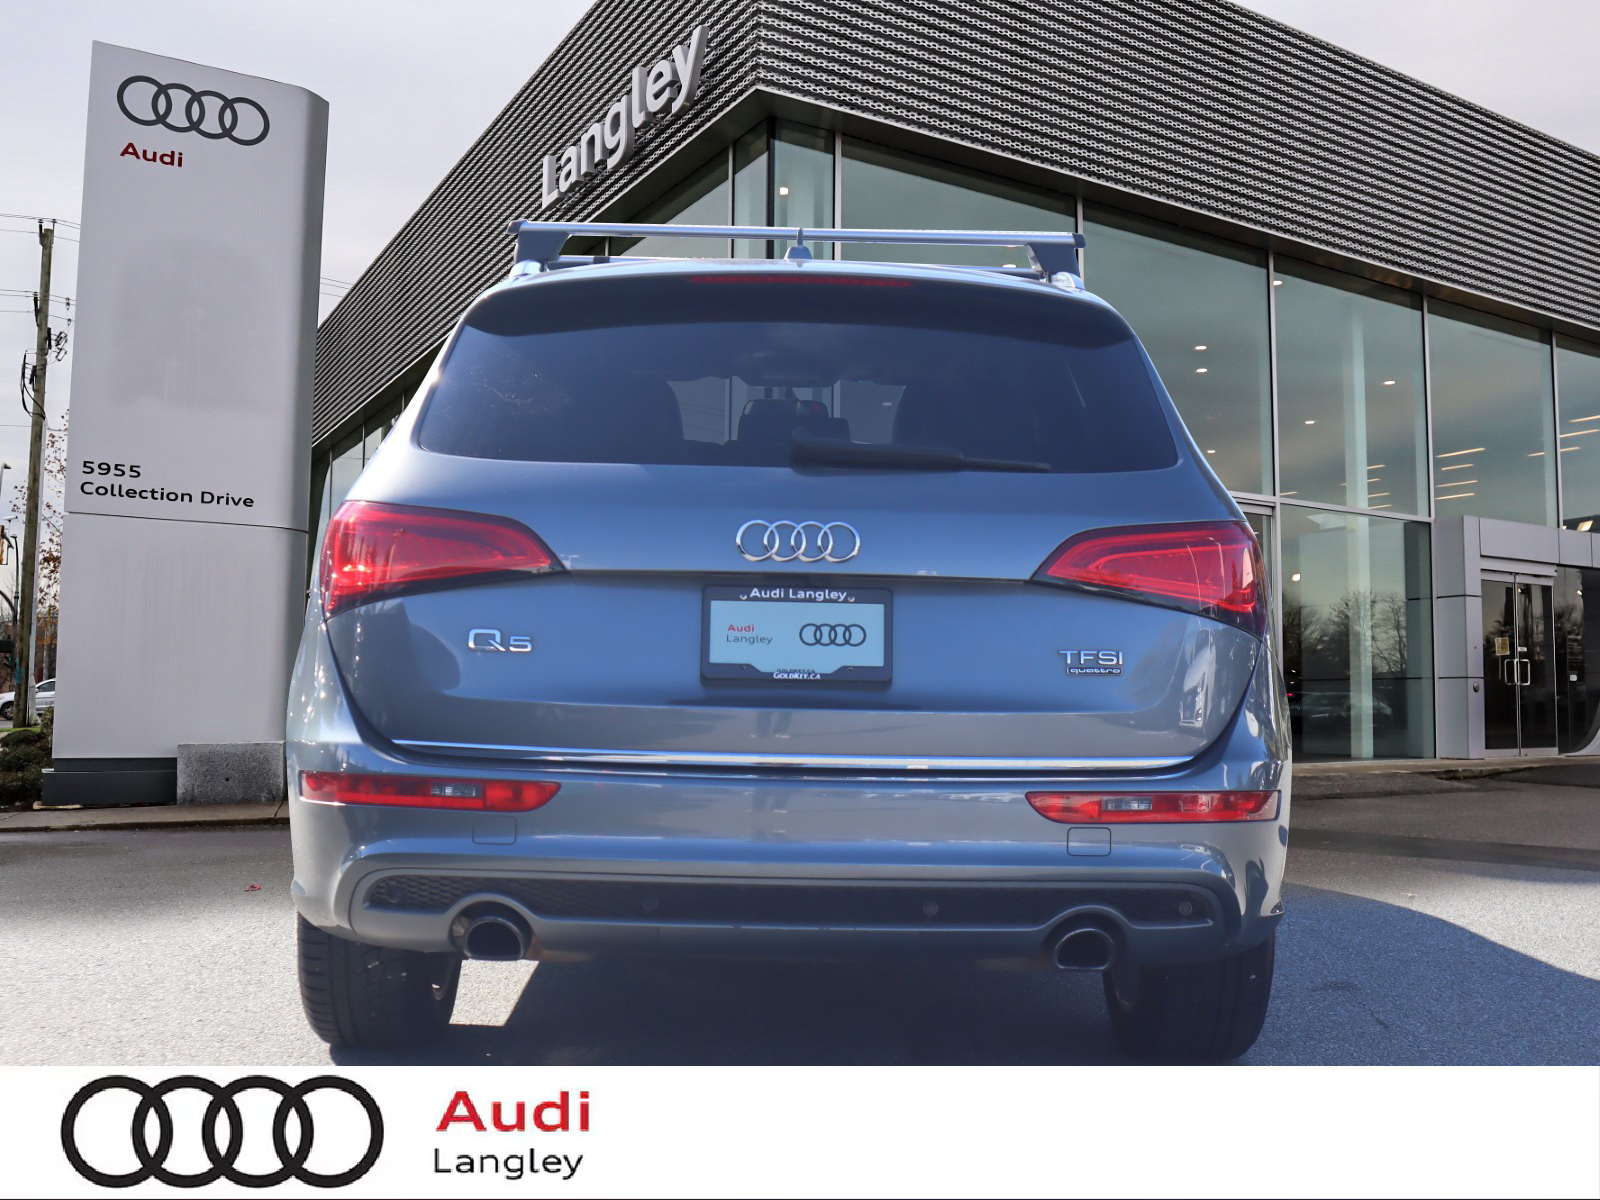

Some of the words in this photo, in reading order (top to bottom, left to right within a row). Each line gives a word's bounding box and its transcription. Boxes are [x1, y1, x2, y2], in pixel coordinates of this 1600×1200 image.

[541, 25, 709, 209] Langley
[120, 142, 183, 168] Audi
[82, 460, 141, 478] 5955
[80, 481, 193, 503] Collection
[200, 491, 254, 507] Drive
[750, 588, 784, 599] Audi
[789, 588, 847, 601] Langley
[727, 624, 755, 632] Audi
[468, 628, 532, 652] Q5
[726, 634, 773, 644] Langley
[1058, 650, 1123, 665] TFSI
